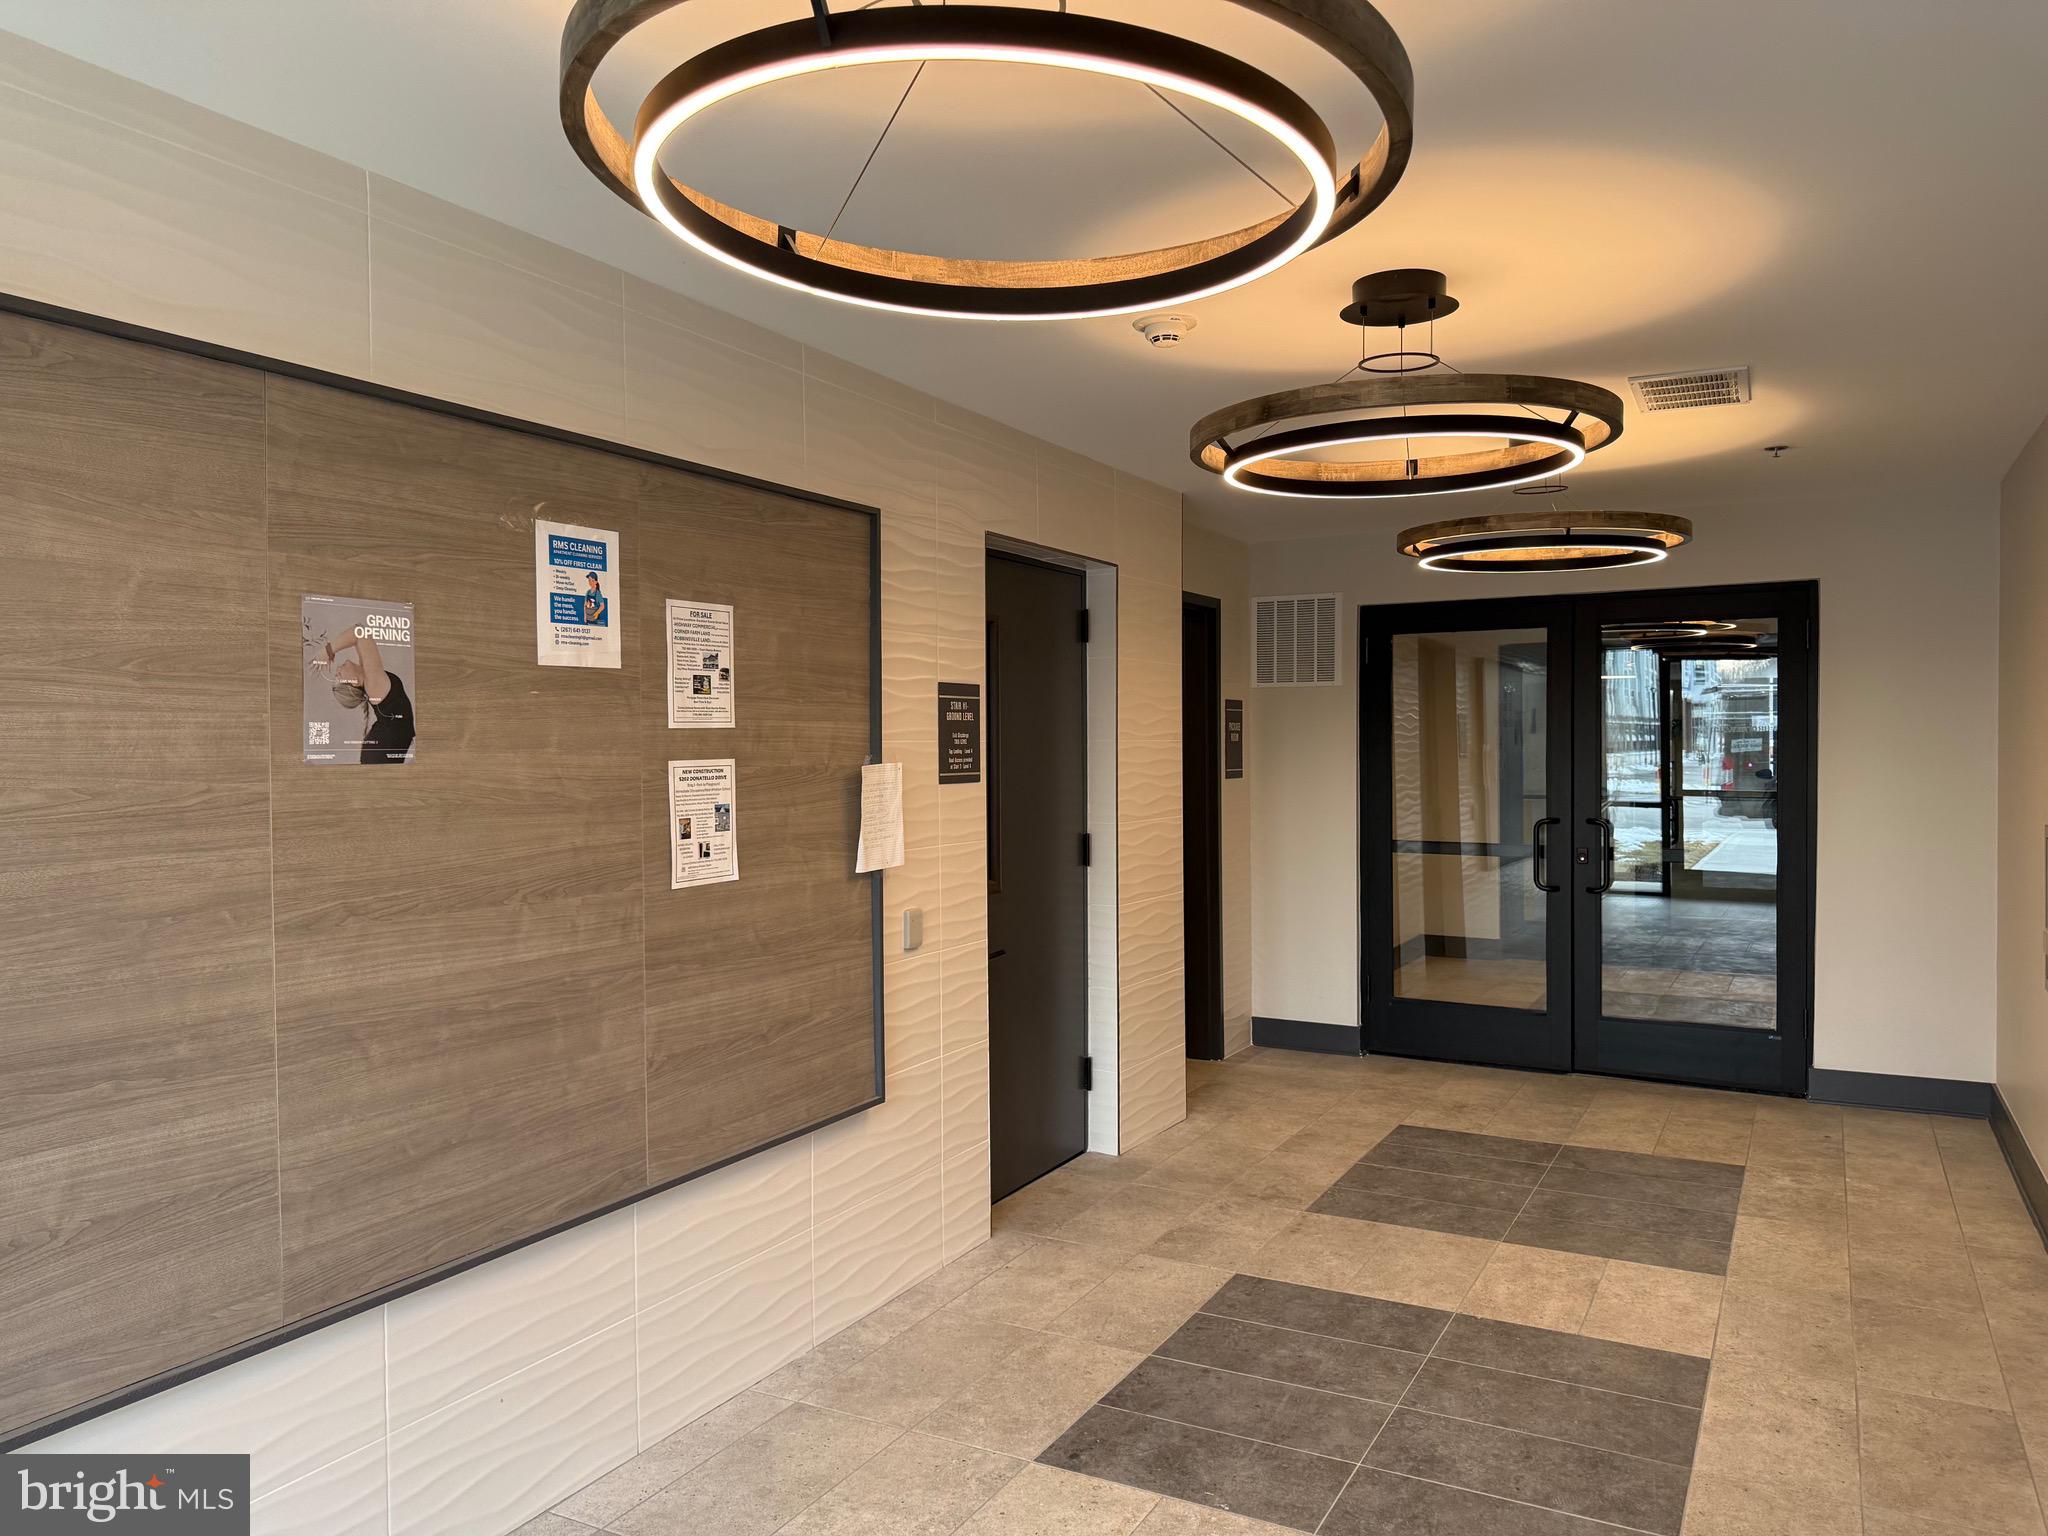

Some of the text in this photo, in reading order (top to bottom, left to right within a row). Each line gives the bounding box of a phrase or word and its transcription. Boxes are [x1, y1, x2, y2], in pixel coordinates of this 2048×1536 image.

[553, 540, 603, 555] RMS CLEANING
[563, 558, 573, 566] OFF
[573, 560, 586, 568] FIRST
[586, 562, 603, 570] CLEAN
[689, 610, 700, 618] FOR
[366, 613, 410, 629] GRAND
[354, 626, 411, 642] OPENING
[950, 701, 962, 710] STAIR
[946, 711, 975, 721] GROUND LEVEL
